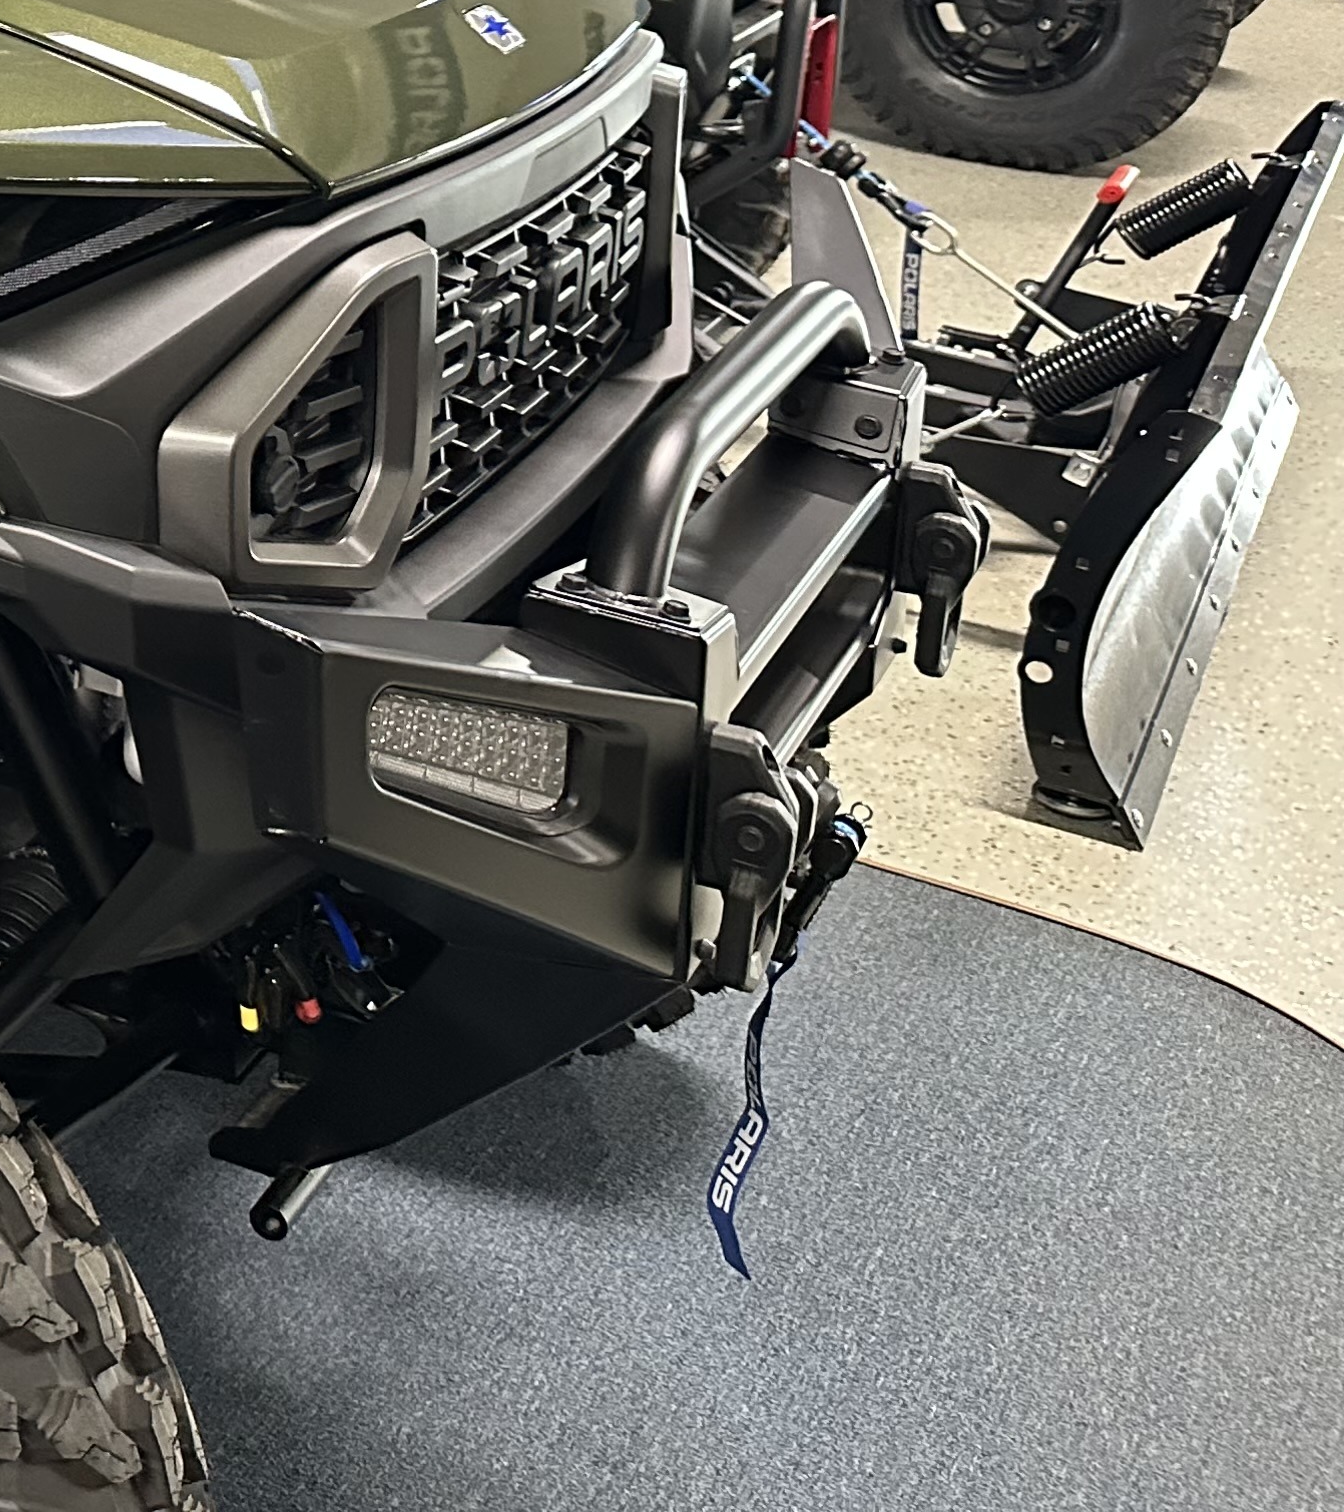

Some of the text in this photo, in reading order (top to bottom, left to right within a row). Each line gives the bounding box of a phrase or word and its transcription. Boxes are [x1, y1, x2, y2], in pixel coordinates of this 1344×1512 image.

[434, 188, 646, 392] POLARIS
[902, 253, 920, 330] POLARIS
[711, 1029, 764, 1214] POLARIS
